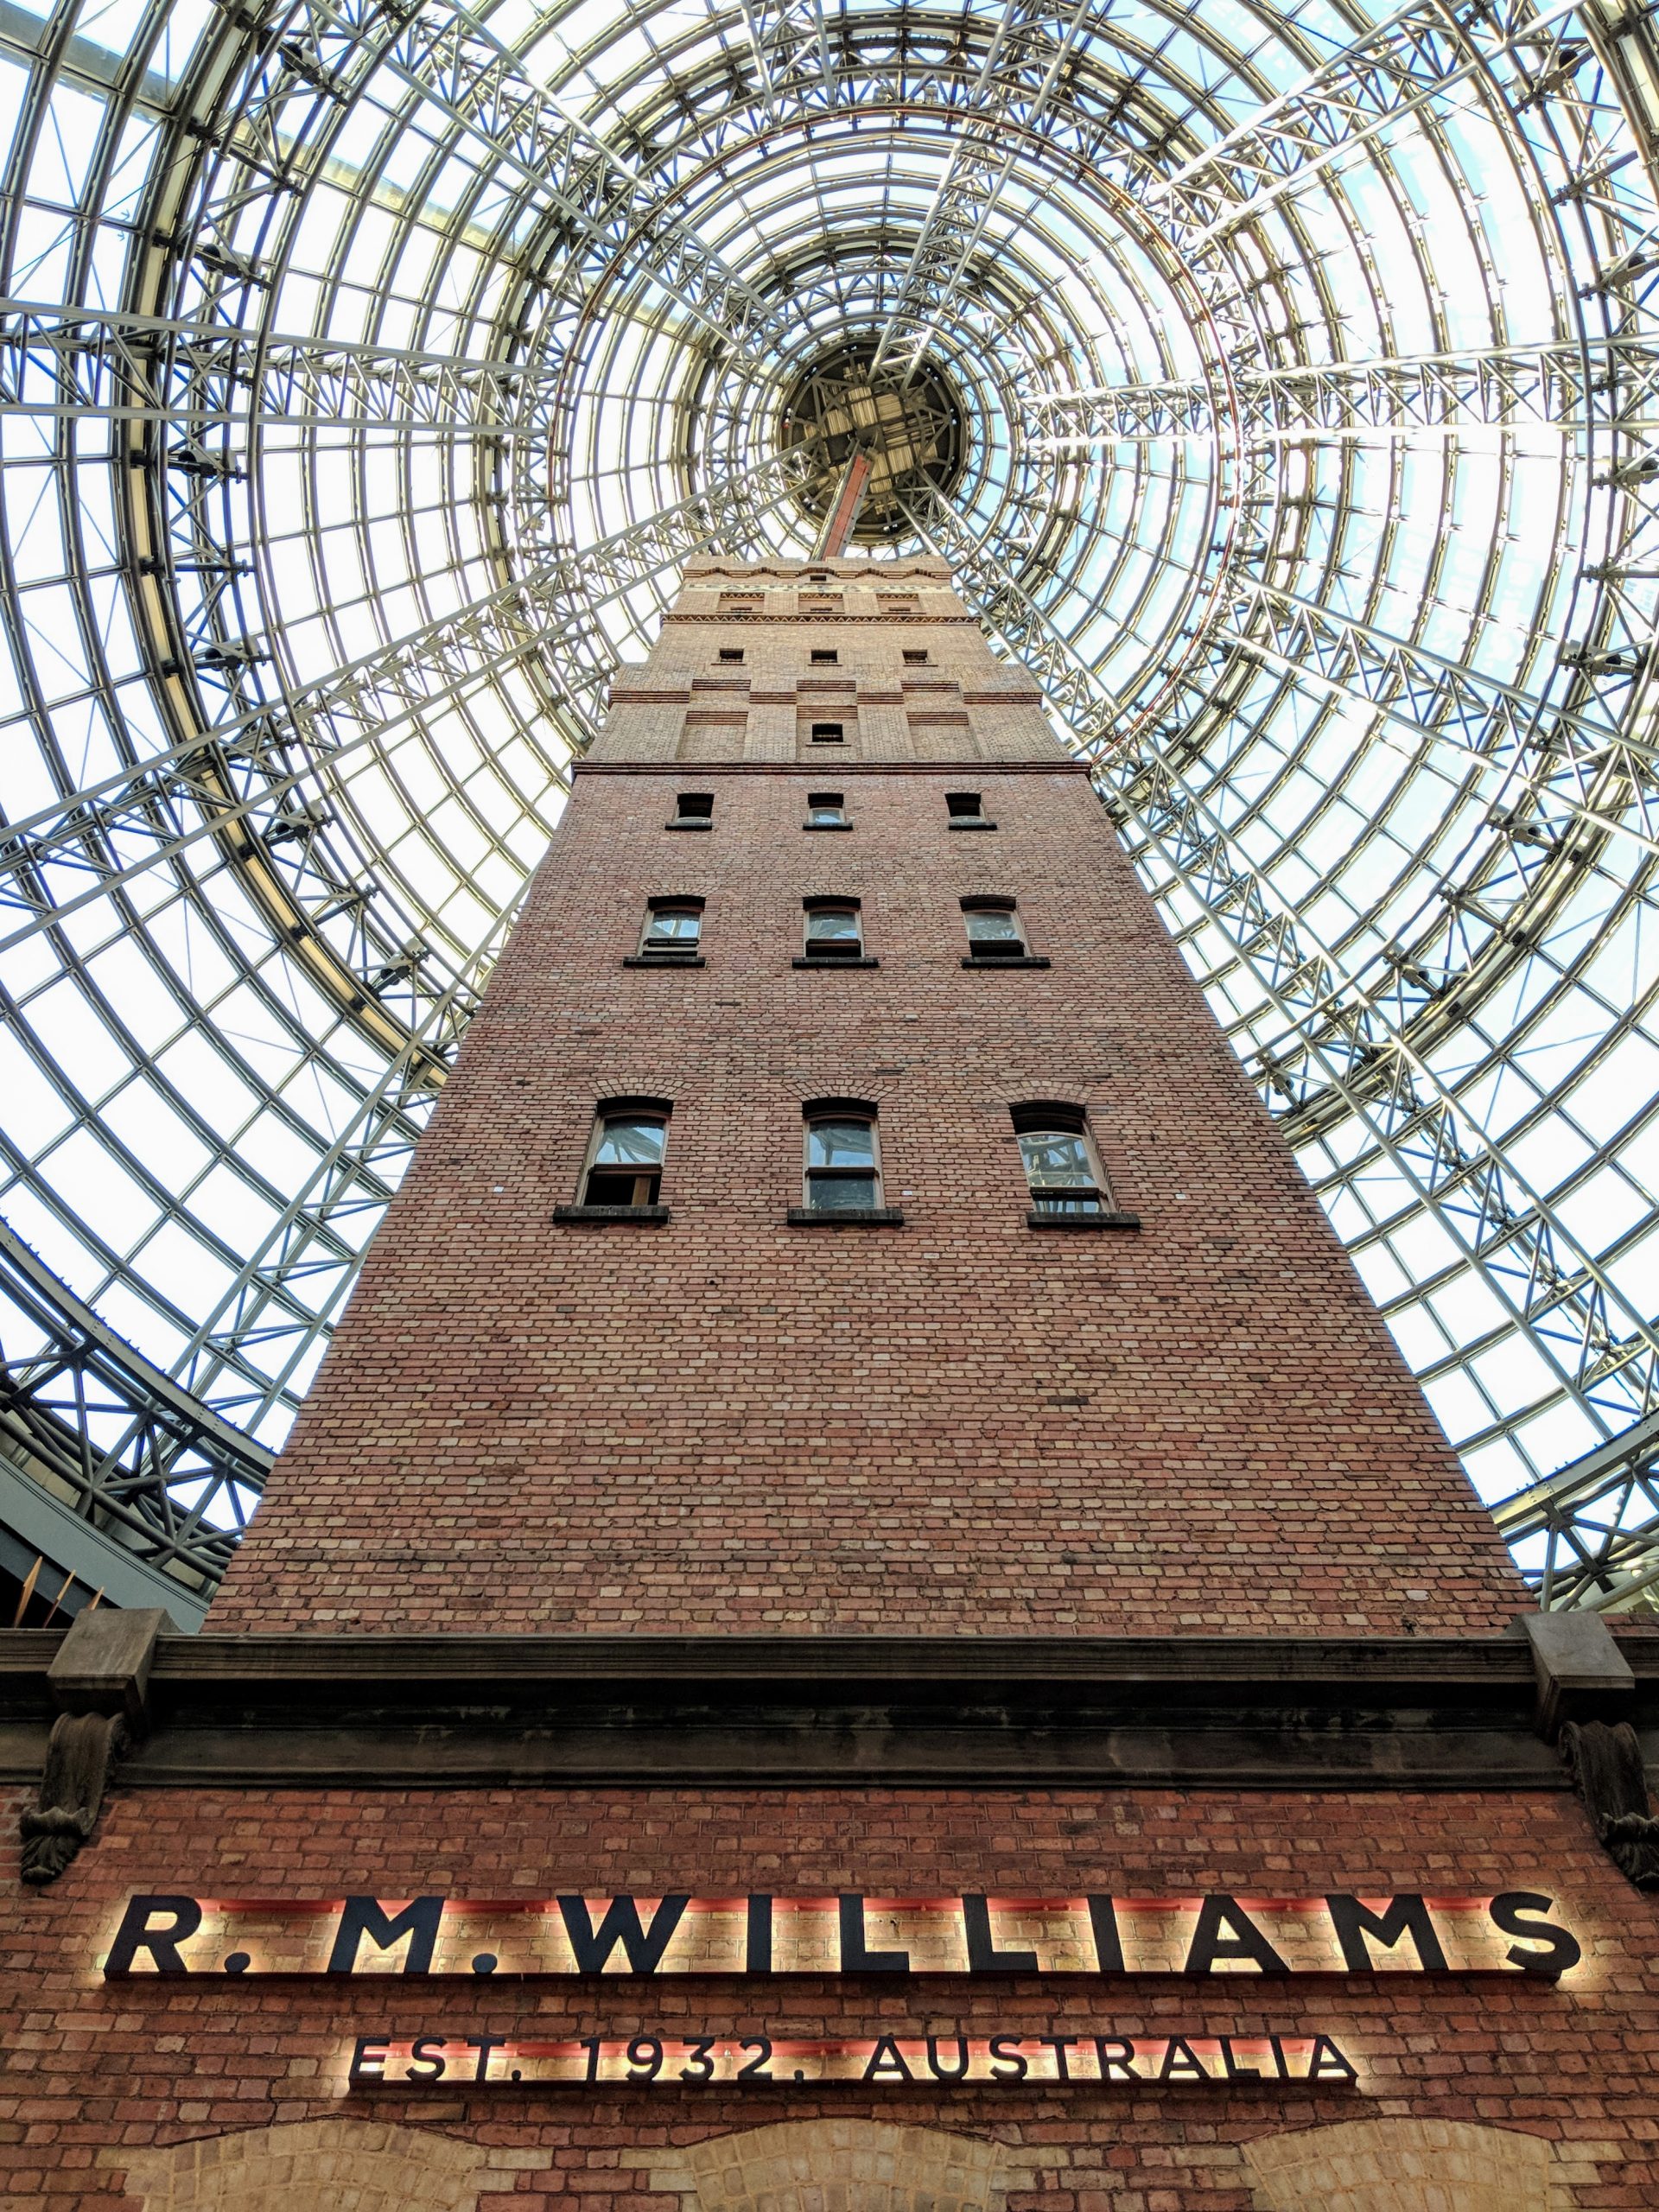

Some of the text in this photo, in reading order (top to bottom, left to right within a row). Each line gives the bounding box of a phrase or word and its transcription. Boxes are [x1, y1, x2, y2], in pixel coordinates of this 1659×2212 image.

[349, 2034, 1359, 2084] EST. 1932. AUSTRALIA
